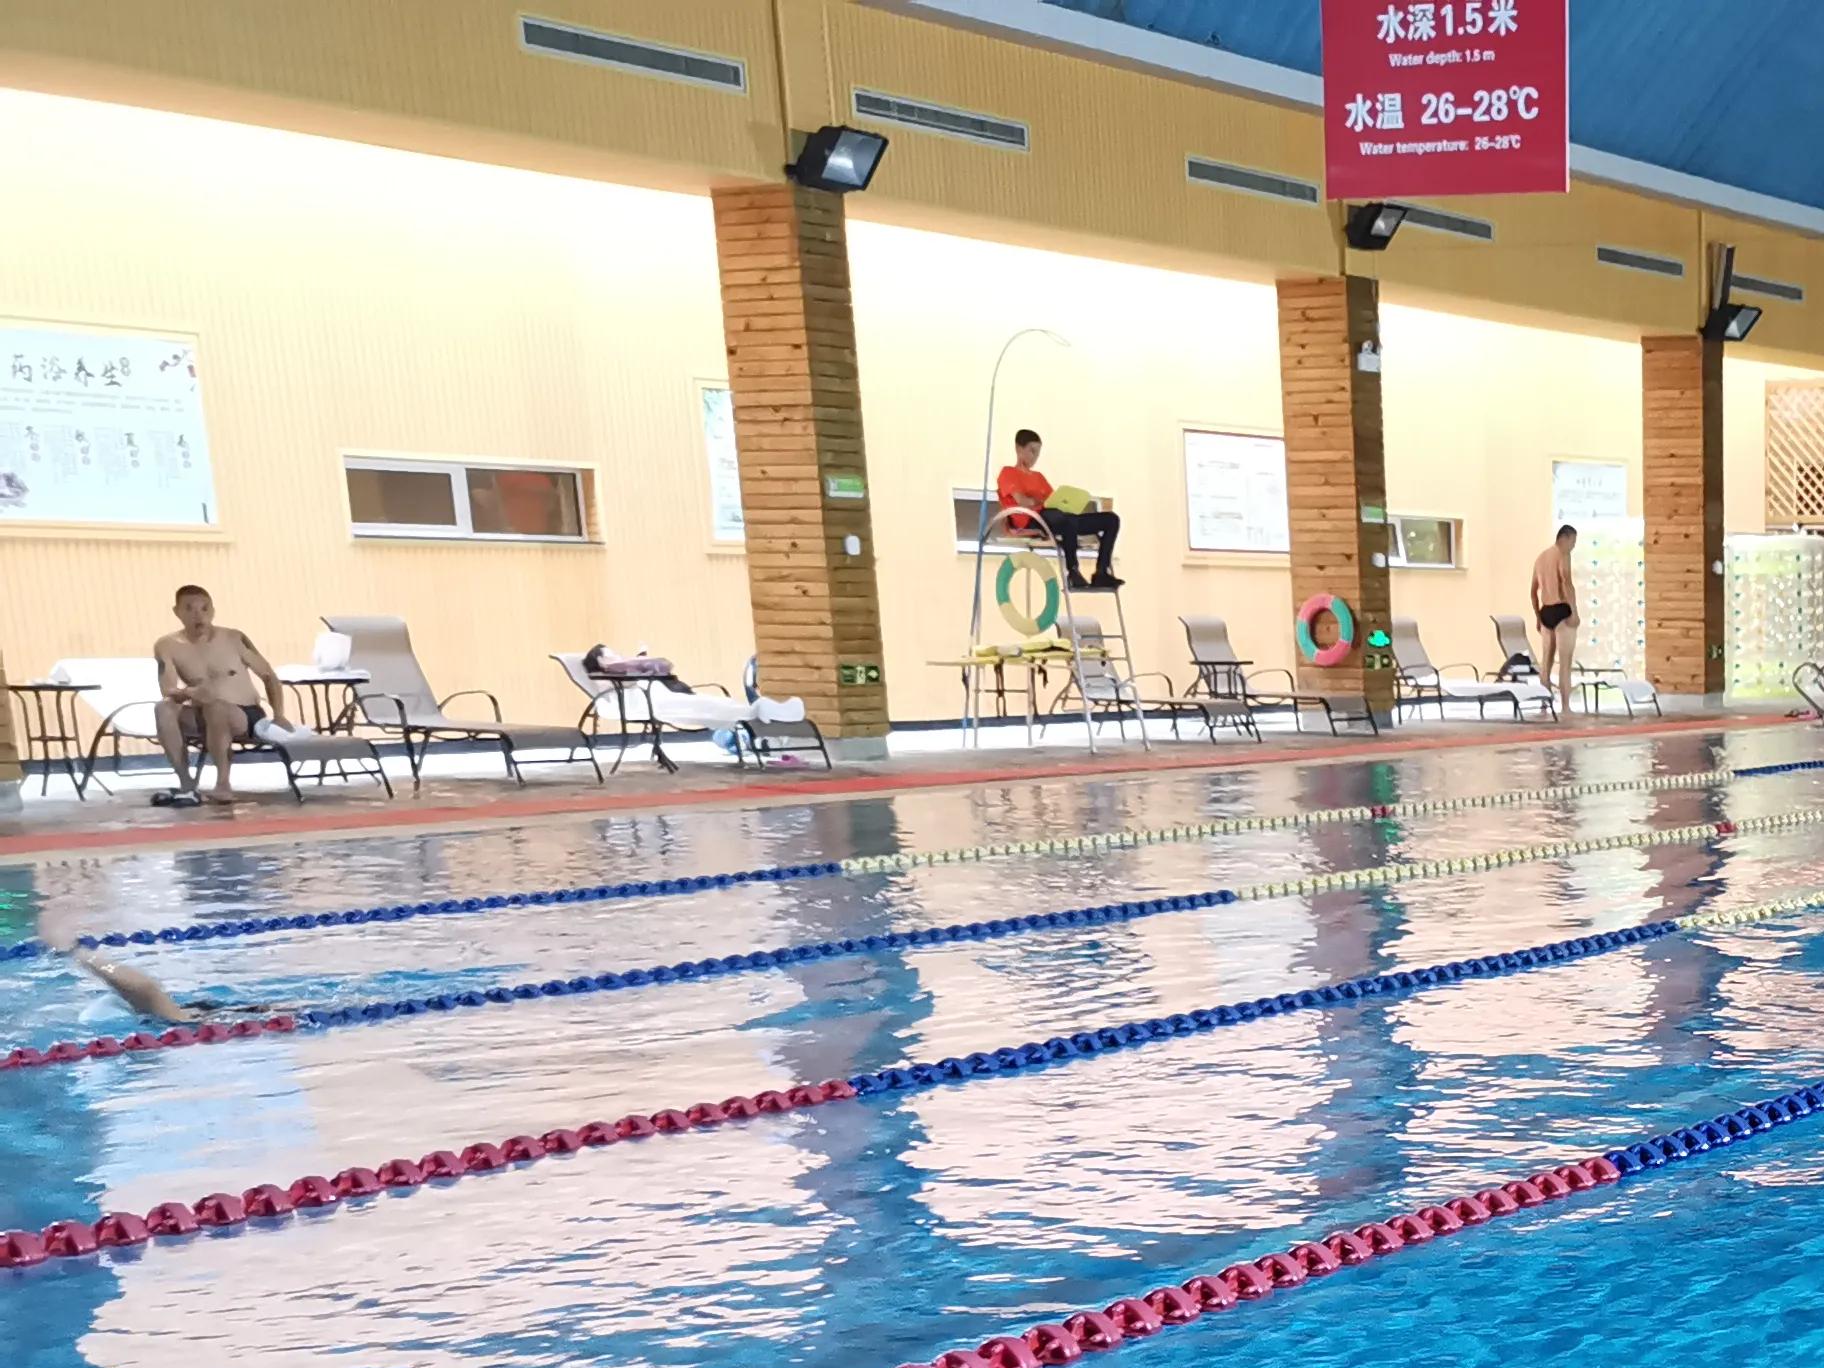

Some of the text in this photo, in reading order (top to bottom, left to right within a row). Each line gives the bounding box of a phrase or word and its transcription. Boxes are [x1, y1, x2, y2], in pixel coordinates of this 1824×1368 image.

[1388, 53, 1424, 67] Water
[1345, 93, 1404, 132] 水温
[1359, 141, 1394, 156] Water
